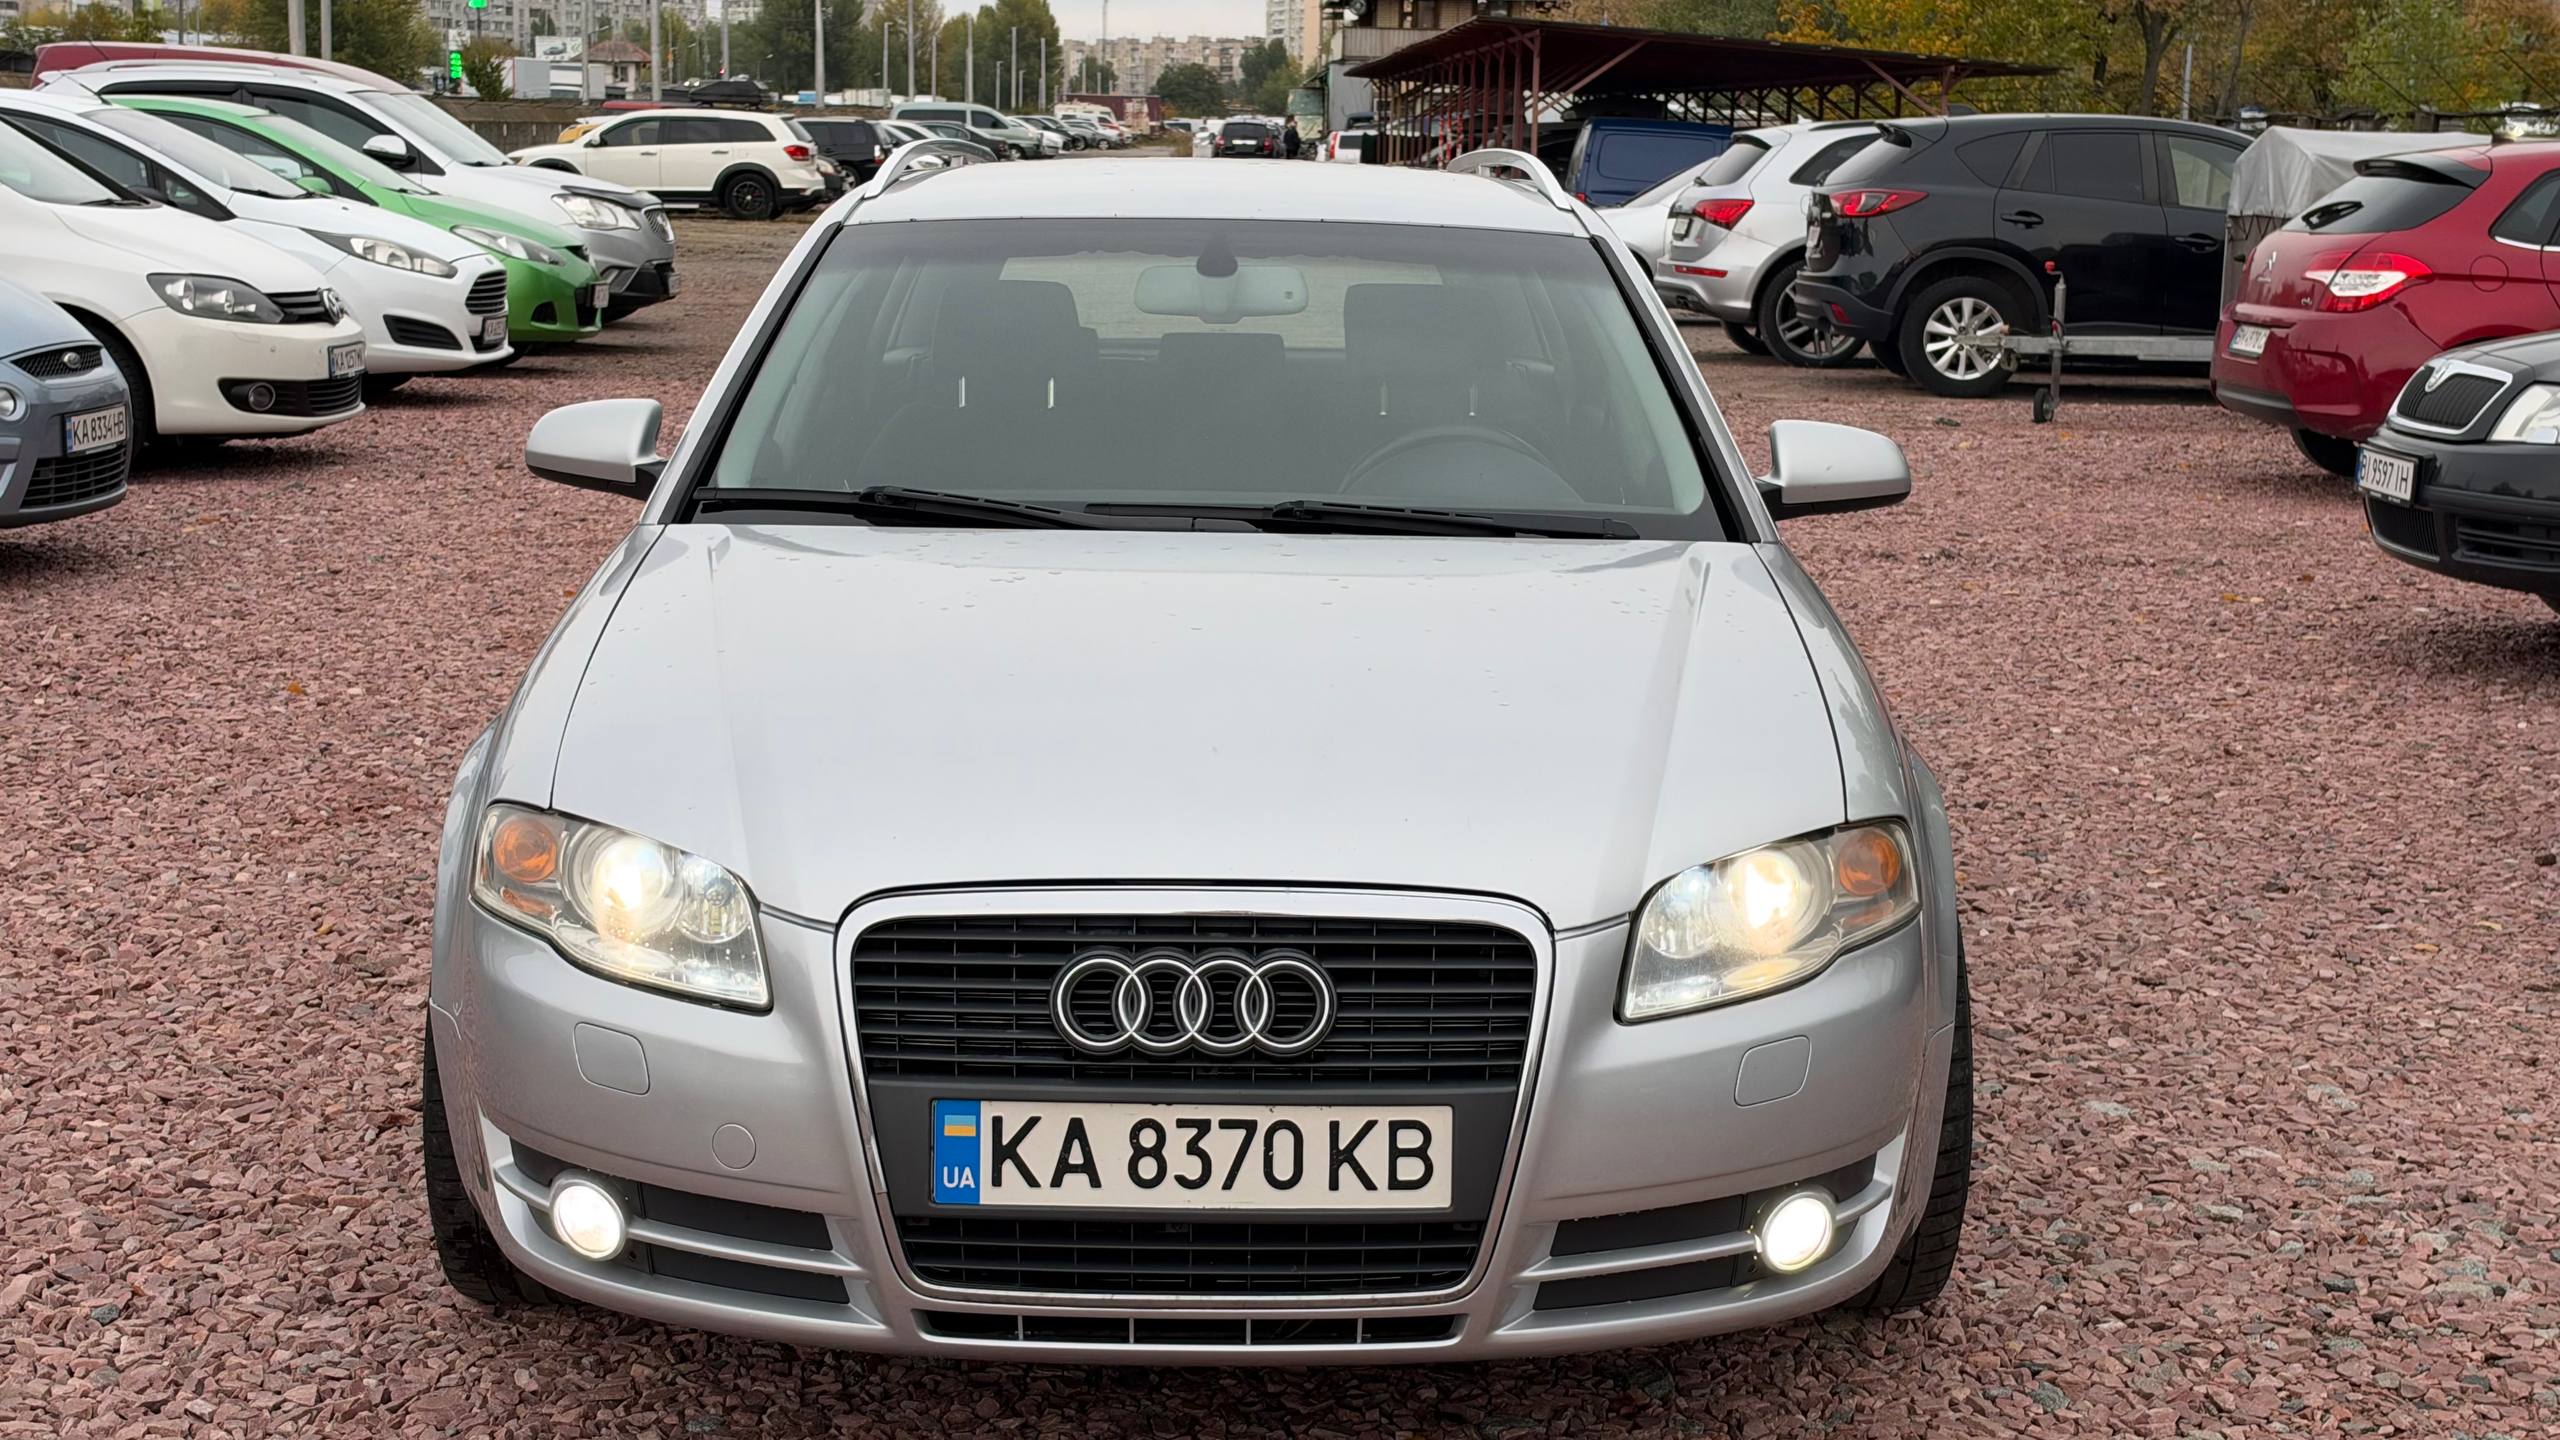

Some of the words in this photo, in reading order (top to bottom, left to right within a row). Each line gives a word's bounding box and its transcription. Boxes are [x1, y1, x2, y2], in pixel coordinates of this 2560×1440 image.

[73, 419, 90, 446] KA
[91, 413, 113, 442] 8334
[113, 411, 124, 438] HB
[2361, 454, 2371, 482] BI
[2371, 458, 2394, 488] 9597
[2395, 464, 2410, 494] IH
[991, 1116, 1101, 1188] KA
[1127, 1118, 1303, 1190] 8370
[1328, 1119, 1434, 1190] KB
[943, 1166, 975, 1189] UA
